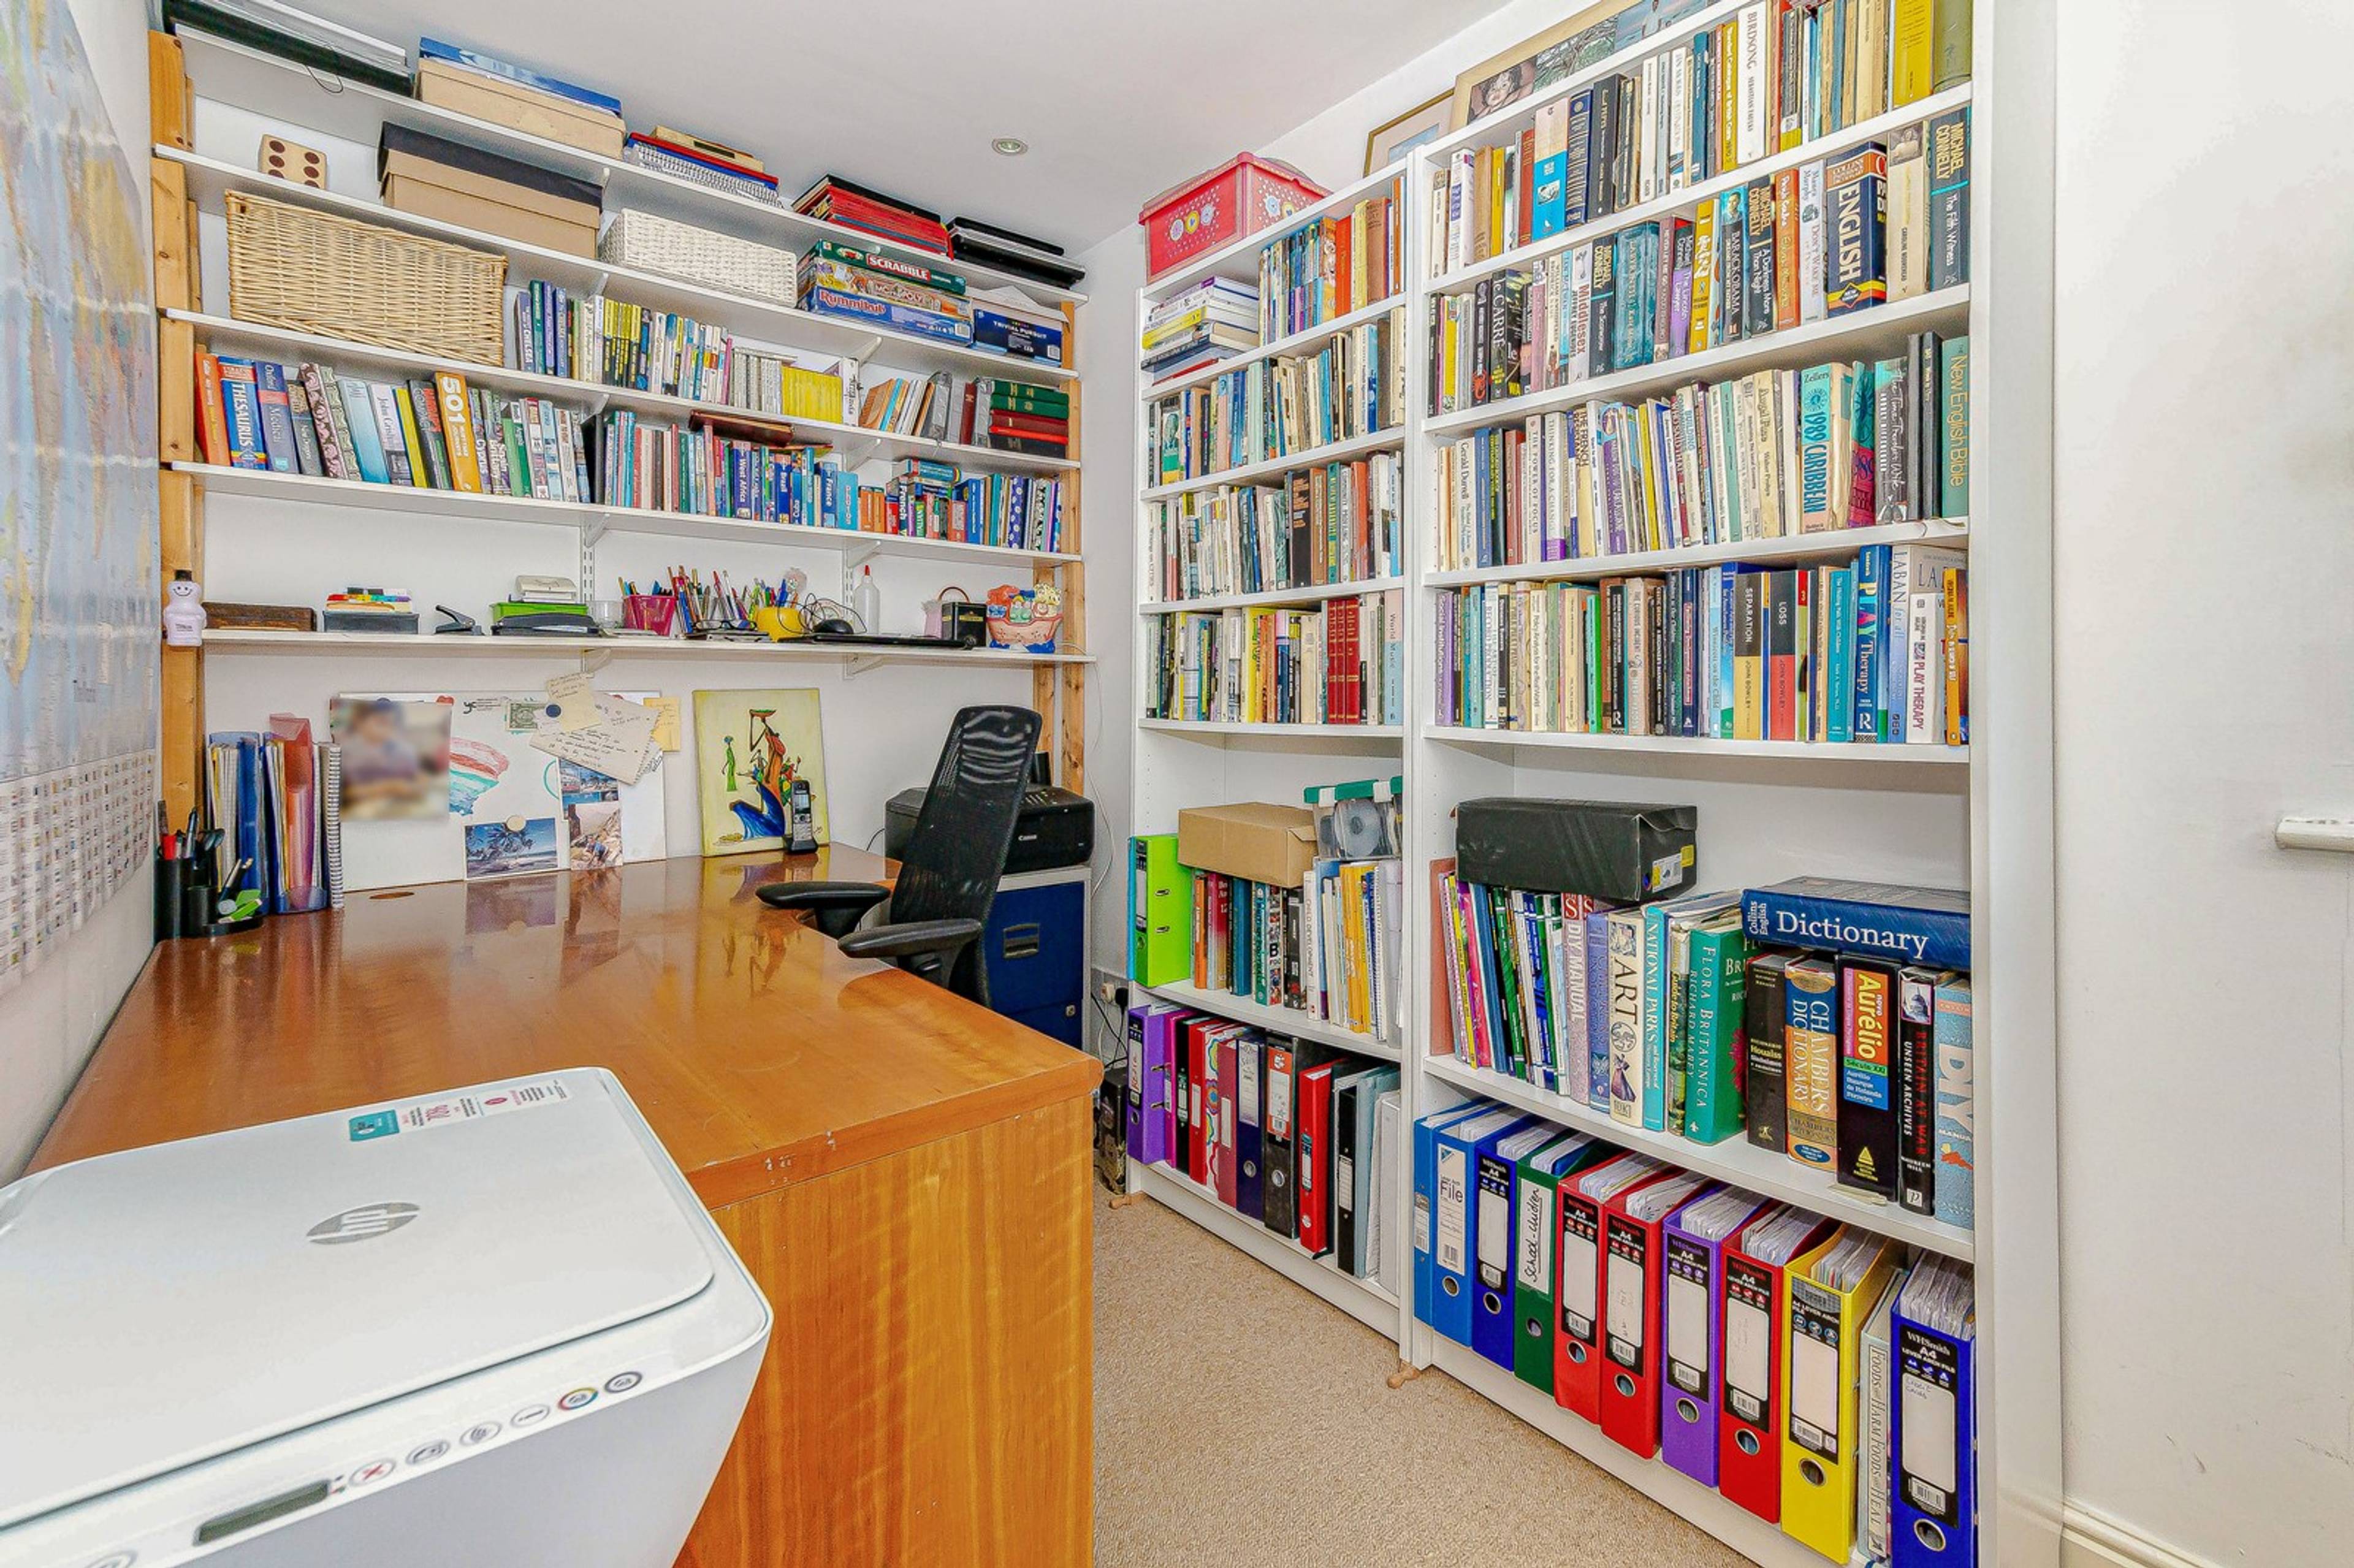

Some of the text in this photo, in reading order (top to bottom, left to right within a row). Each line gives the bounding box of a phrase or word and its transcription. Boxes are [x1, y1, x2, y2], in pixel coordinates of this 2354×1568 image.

[1746, 12, 1758, 70] BIRDSONG
[1937, 123, 1964, 180] MICHAEL CONNELLY
[1748, 186, 1772, 235] MICHAEL CONNELLY
[1838, 181, 1862, 284] ENGLISH
[1945, 194, 1958, 267] The Fifth Witness
[868, 256, 929, 281] SCRABBLE
[1593, 245, 1604, 289] CONNELLY
[1731, 230, 1740, 315] BARACK OBAMA
[523, 329, 535, 364] CHELSEA
[1577, 284, 1590, 354] Middlesex
[230, 382, 255, 447] THESAURUS
[264, 364, 282, 443] Oxford Medical
[376, 397, 390, 416] John
[441, 376, 467, 424] 501
[1947, 354, 1967, 487] New English Bible
[476, 439, 489, 475] Cyprus
[1460, 442, 1471, 500] Gerald Durrell
[1580, 429, 1589, 466] FRENCH
[1803, 411, 1827, 514] 1989 CARIBBEAN
[738, 459, 747, 503] West Africa
[825, 478, 834, 507] France
[899, 484, 907, 520] French
[1532, 487, 1539, 500] OF
[1891, 551, 1908, 604] LABAN
[1438, 595, 1447, 674] Social Institutions
[1744, 587, 1754, 643] SEPARATION
[1778, 601, 1788, 626] LOSS
[1857, 582, 1877, 694] PLAY Therapy
[1912, 661, 1925, 730] PLAY THERAPY
[1748, 900, 1770, 936] Collins English
[1775, 910, 1930, 961] Dictionary
[1567, 923, 1585, 1023] DIY MANUAL
[1614, 957, 1639, 1025] ART
[1645, 921, 1659, 1043] NATIONAL PARKS
[1688, 969, 1698, 1030] RICHARD
[1700, 946, 1716, 999] FLORA
[1857, 972, 1883, 1060] Aurélio
[1696, 1008, 1714, 1108] BRITANNICA
[1792, 999, 1808, 1108] DICTIONARY
[1810, 1000, 1831, 1113] CHAMBERS
[1903, 1041, 1913, 1136] UNSEEN ARCHIVES
[1916, 1030, 1929, 1155] BRITAIN AT WAR
[1938, 1042, 1973, 1134] DIY
[1439, 1179, 1464, 1203] File
[1681, 1250, 1694, 1261] A4
[1742, 1273, 1756, 1285] A4
[1906, 1331, 1951, 1356] WHSmith
[1919, 1346, 1937, 1360] A4
[1871, 1349, 1886, 1526] FOODS HARM FOODS HEAL
